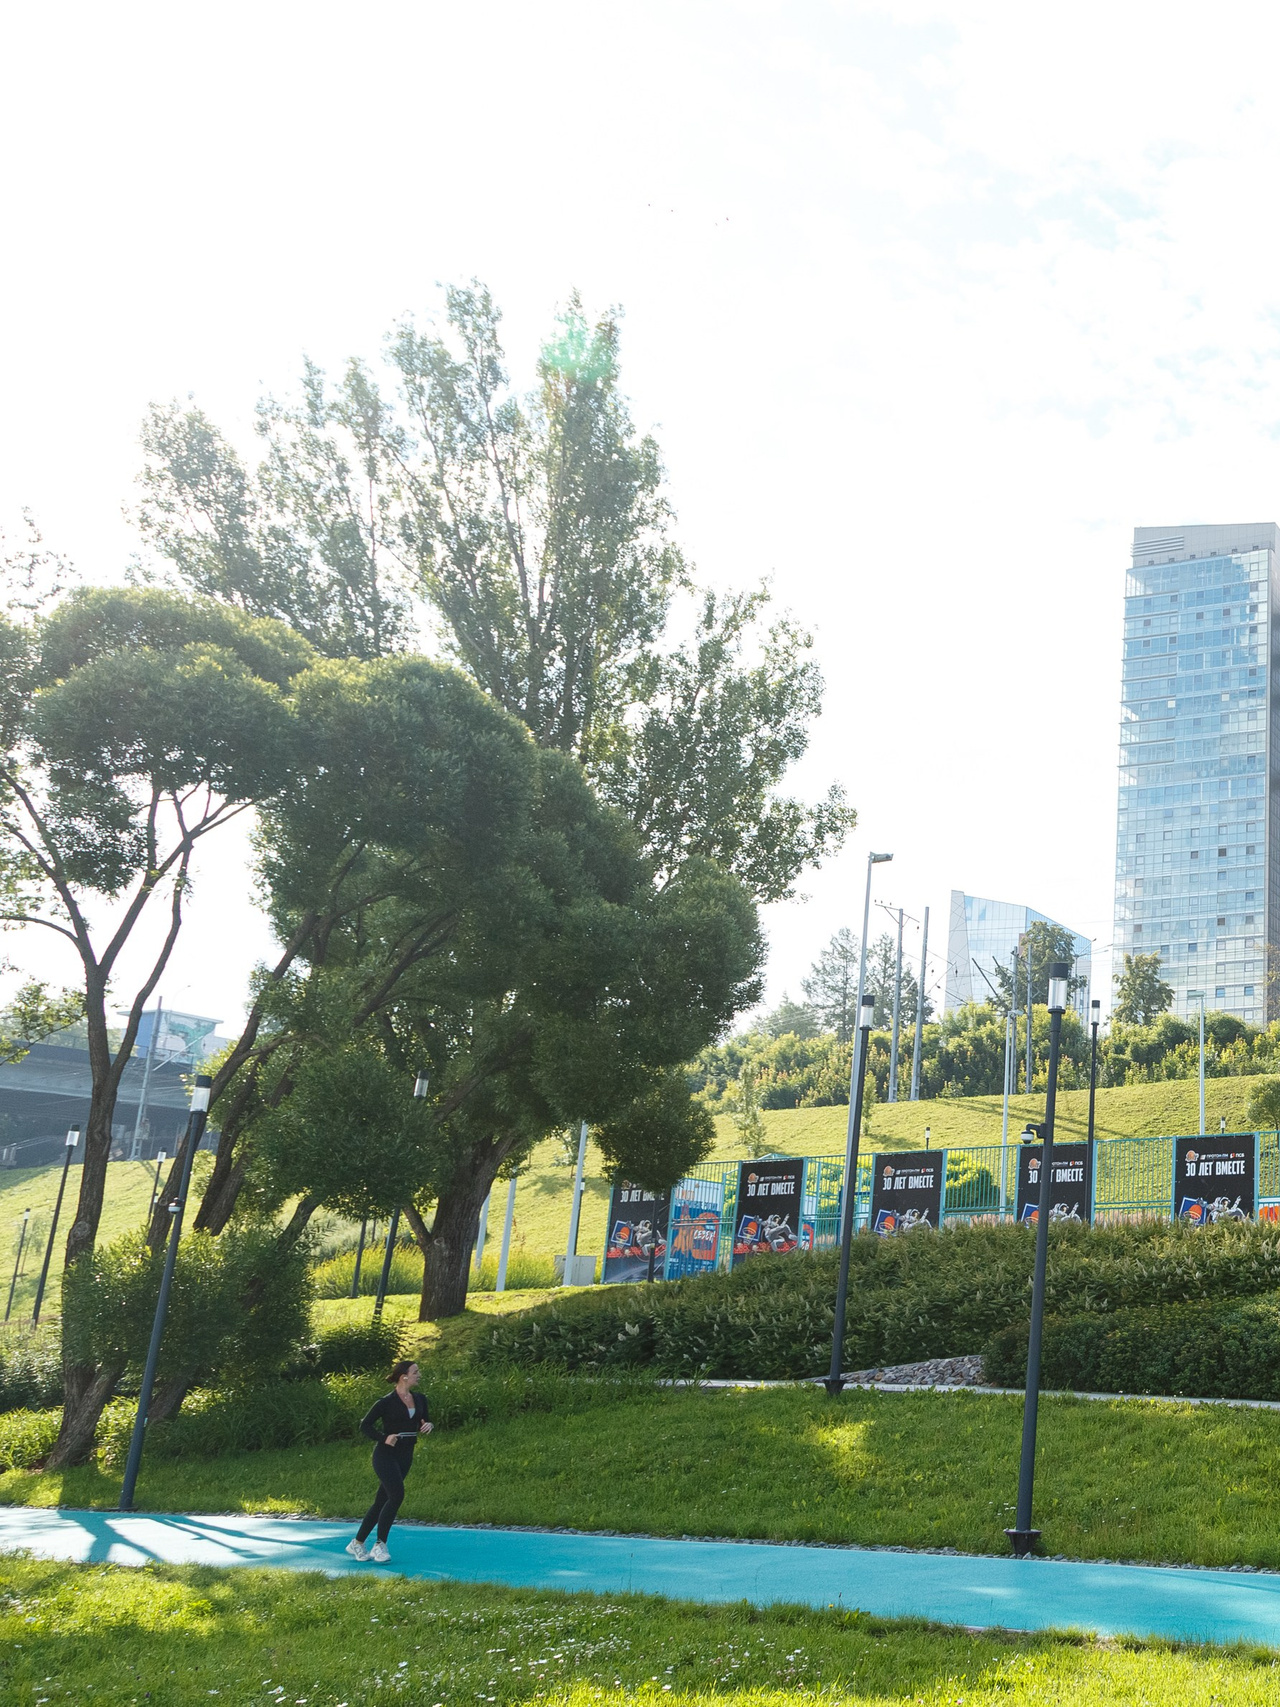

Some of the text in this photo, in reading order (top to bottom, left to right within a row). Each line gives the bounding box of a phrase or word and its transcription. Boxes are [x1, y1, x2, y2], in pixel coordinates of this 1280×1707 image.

[1028, 1169, 1038, 1184] 30
[1055, 1168, 1084, 1183] ВМЕСТЕ
[1185, 1160, 1245, 1177] 30 ЛЕТ ВМЕСТЕ
[746, 1181, 795, 1197] 30 ЛЕТ ВМЕСТЕ
[882, 1175, 935, 1190] 30 ЛЕТ ВМЕСТЕ
[620, 1190, 629, 1203] 30
[629, 1189, 643, 1202] ЛЕТ
